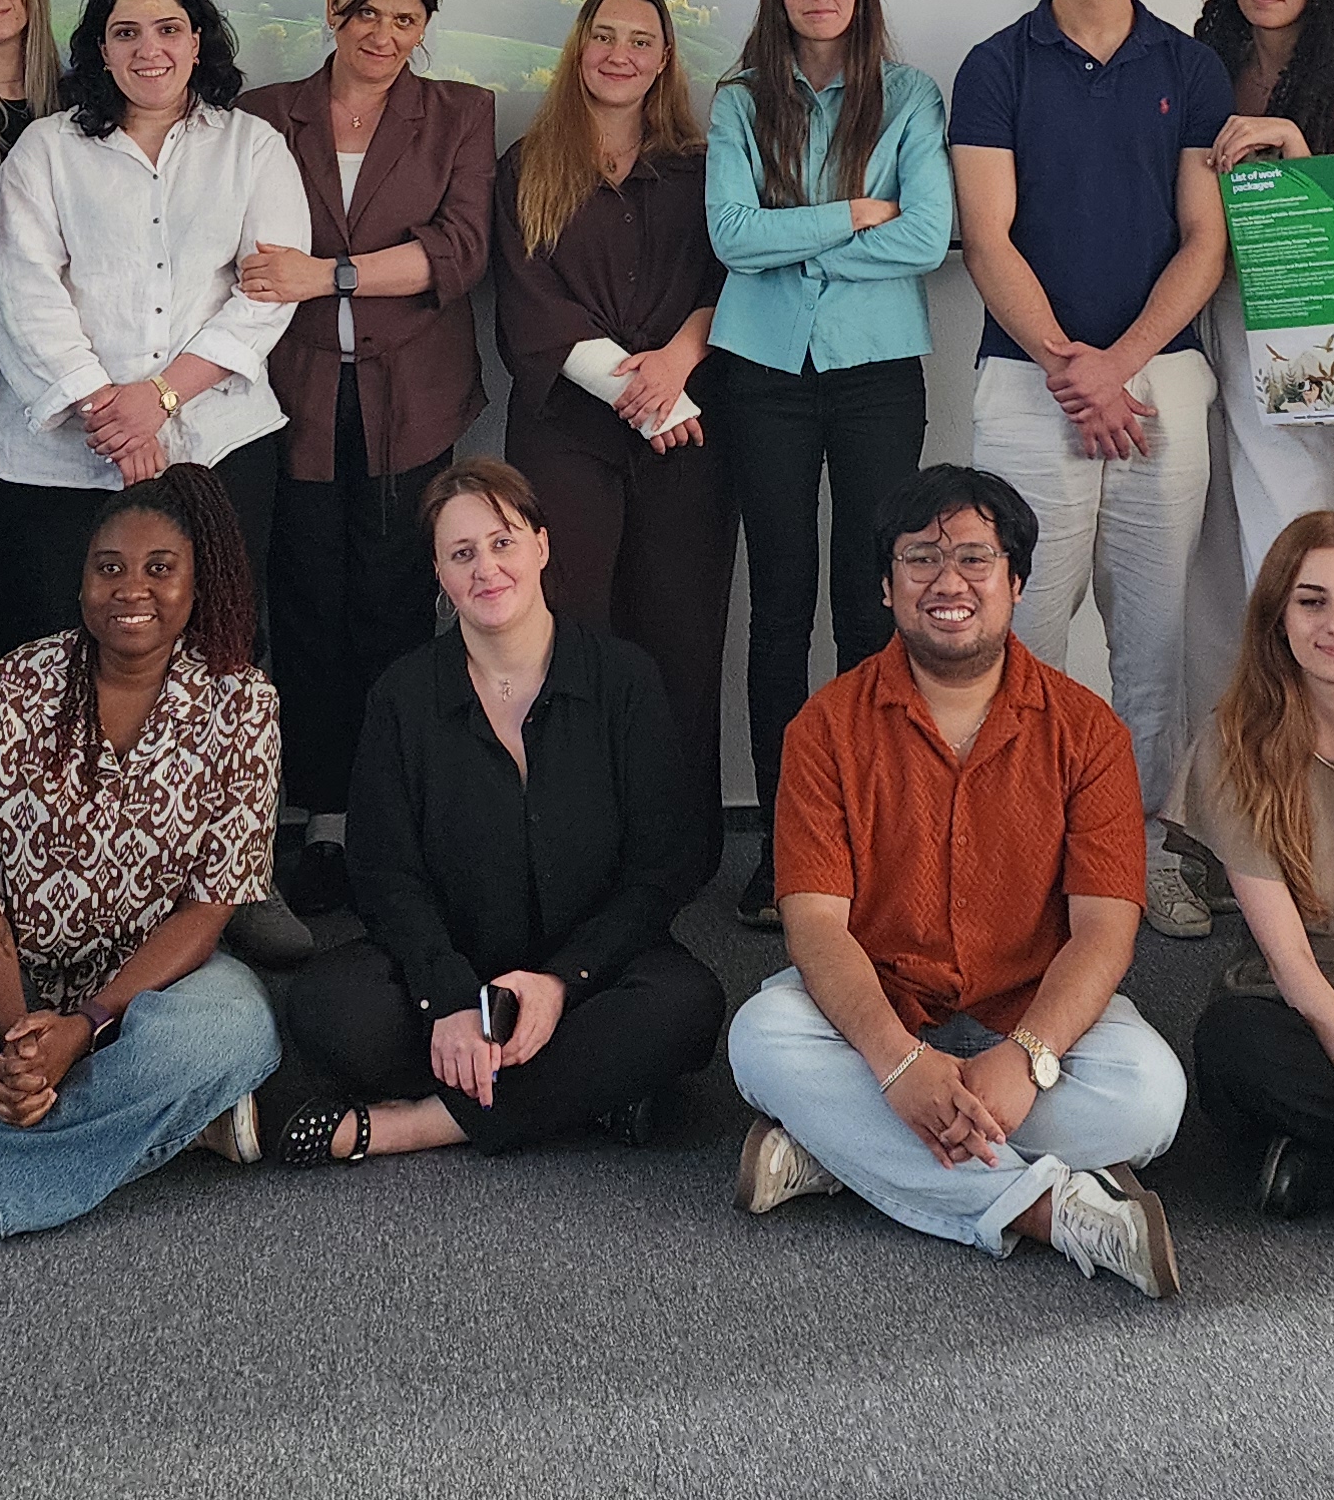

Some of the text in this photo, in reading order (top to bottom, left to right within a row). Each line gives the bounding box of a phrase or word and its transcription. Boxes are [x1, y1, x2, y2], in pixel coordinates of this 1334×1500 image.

[1230, 168, 1283, 183] List of work
[1232, 180, 1275, 195] packages
